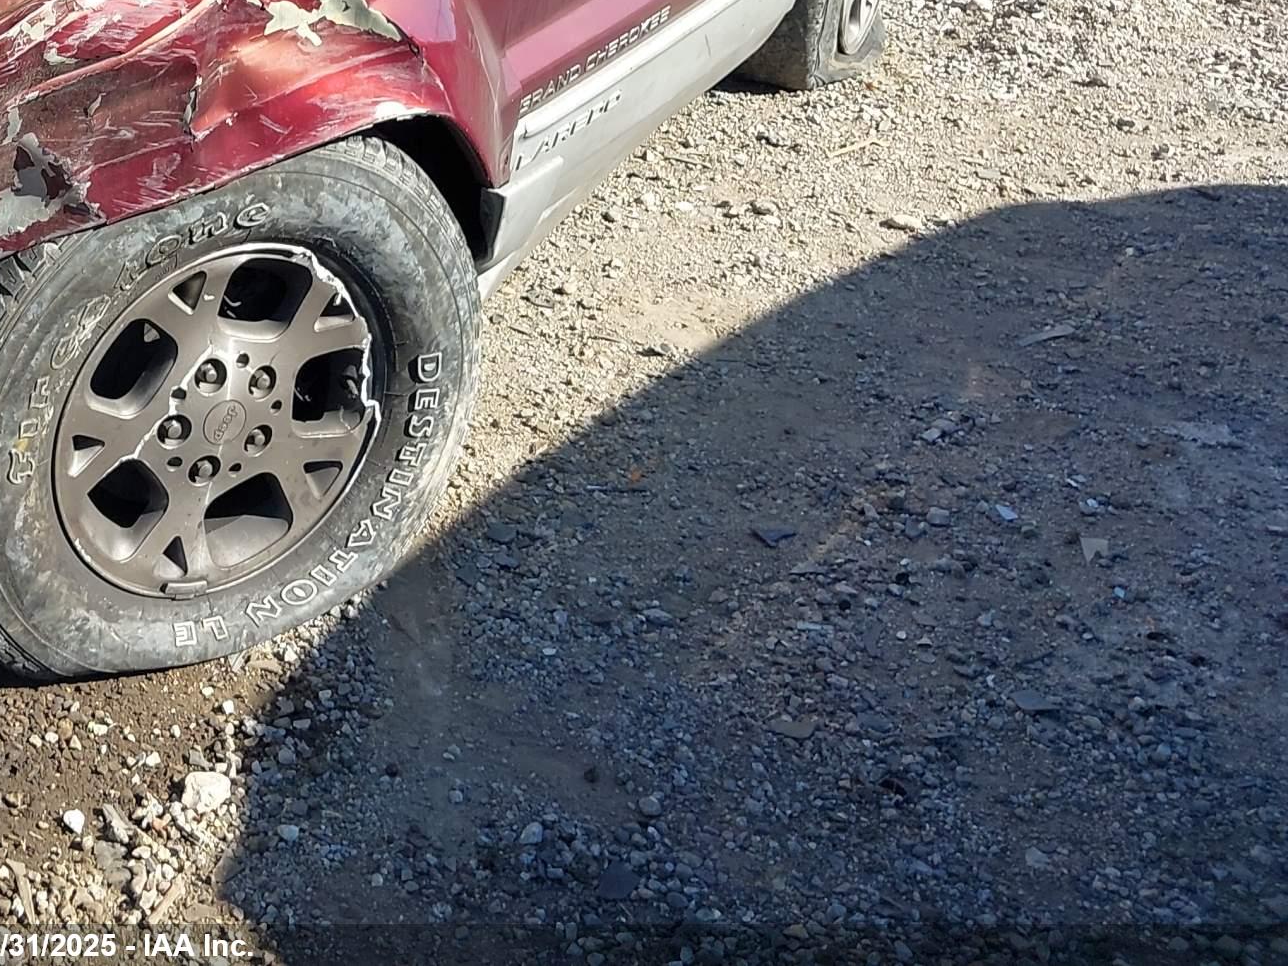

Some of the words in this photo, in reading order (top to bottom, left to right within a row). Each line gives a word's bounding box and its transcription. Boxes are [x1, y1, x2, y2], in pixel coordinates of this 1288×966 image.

[519, 63, 582, 113] GRAND
[585, 5, 672, 72] CHEROKEE
[245, 351, 442, 627] DESTINATION
[173, 615, 230, 647] LE
